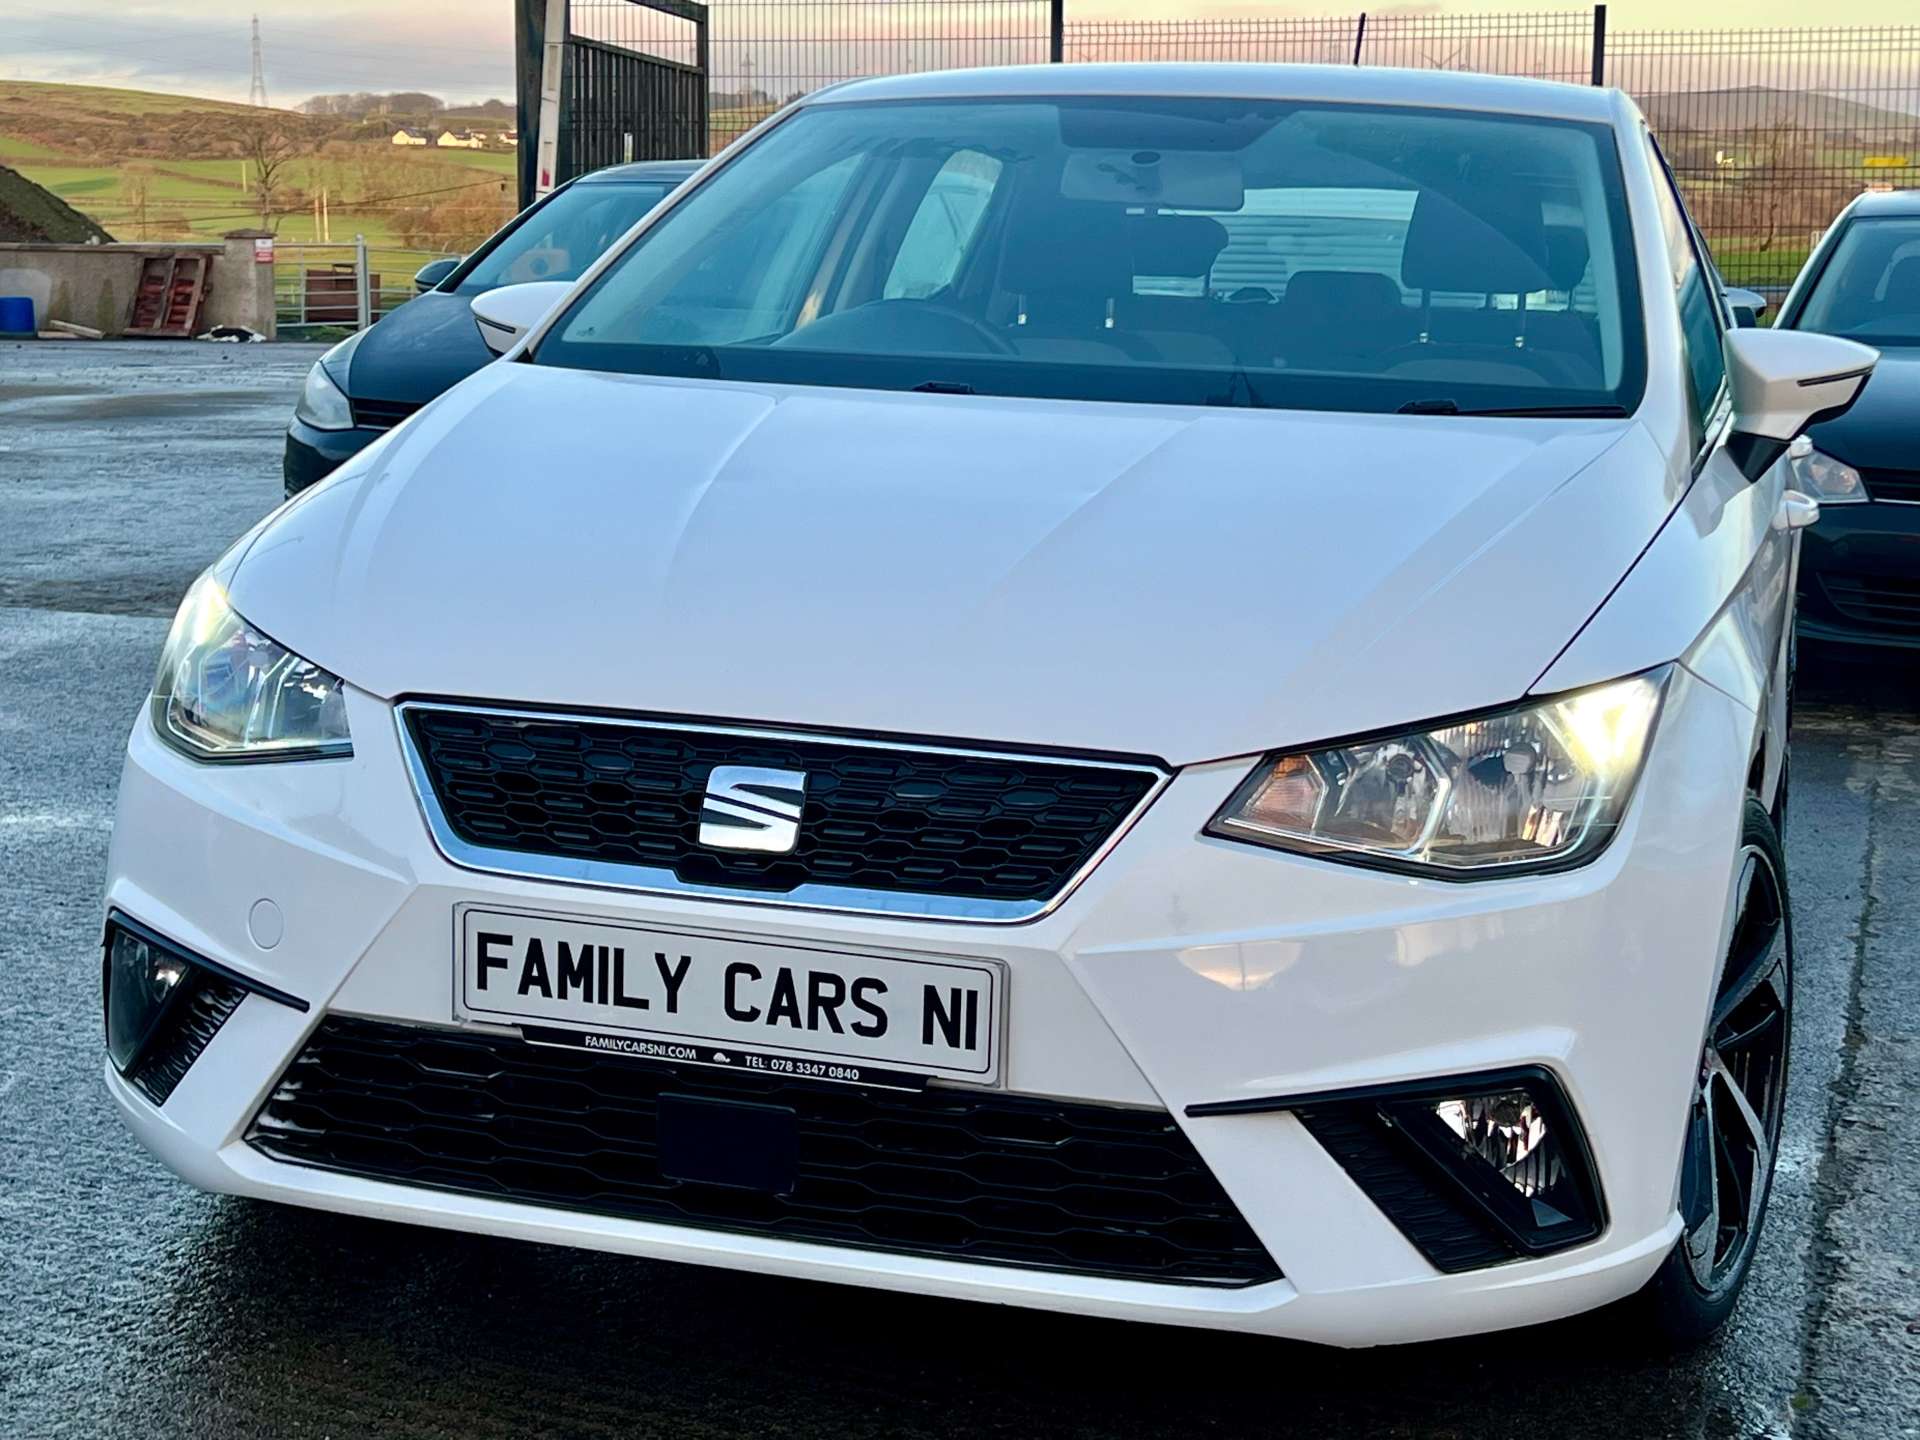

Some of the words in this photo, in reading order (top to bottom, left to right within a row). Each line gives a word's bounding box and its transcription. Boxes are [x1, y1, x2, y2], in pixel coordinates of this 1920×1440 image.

[476, 931, 692, 1015] FAMILY
[724, 961, 889, 1039] CARS
[921, 984, 979, 1051] NI
[584, 1035, 697, 1060] FAMILYCARSNI.COM
[770, 1059, 794, 1073] 078
[796, 1061, 826, 1077] 3347
[828, 1066, 860, 1081] 0840
